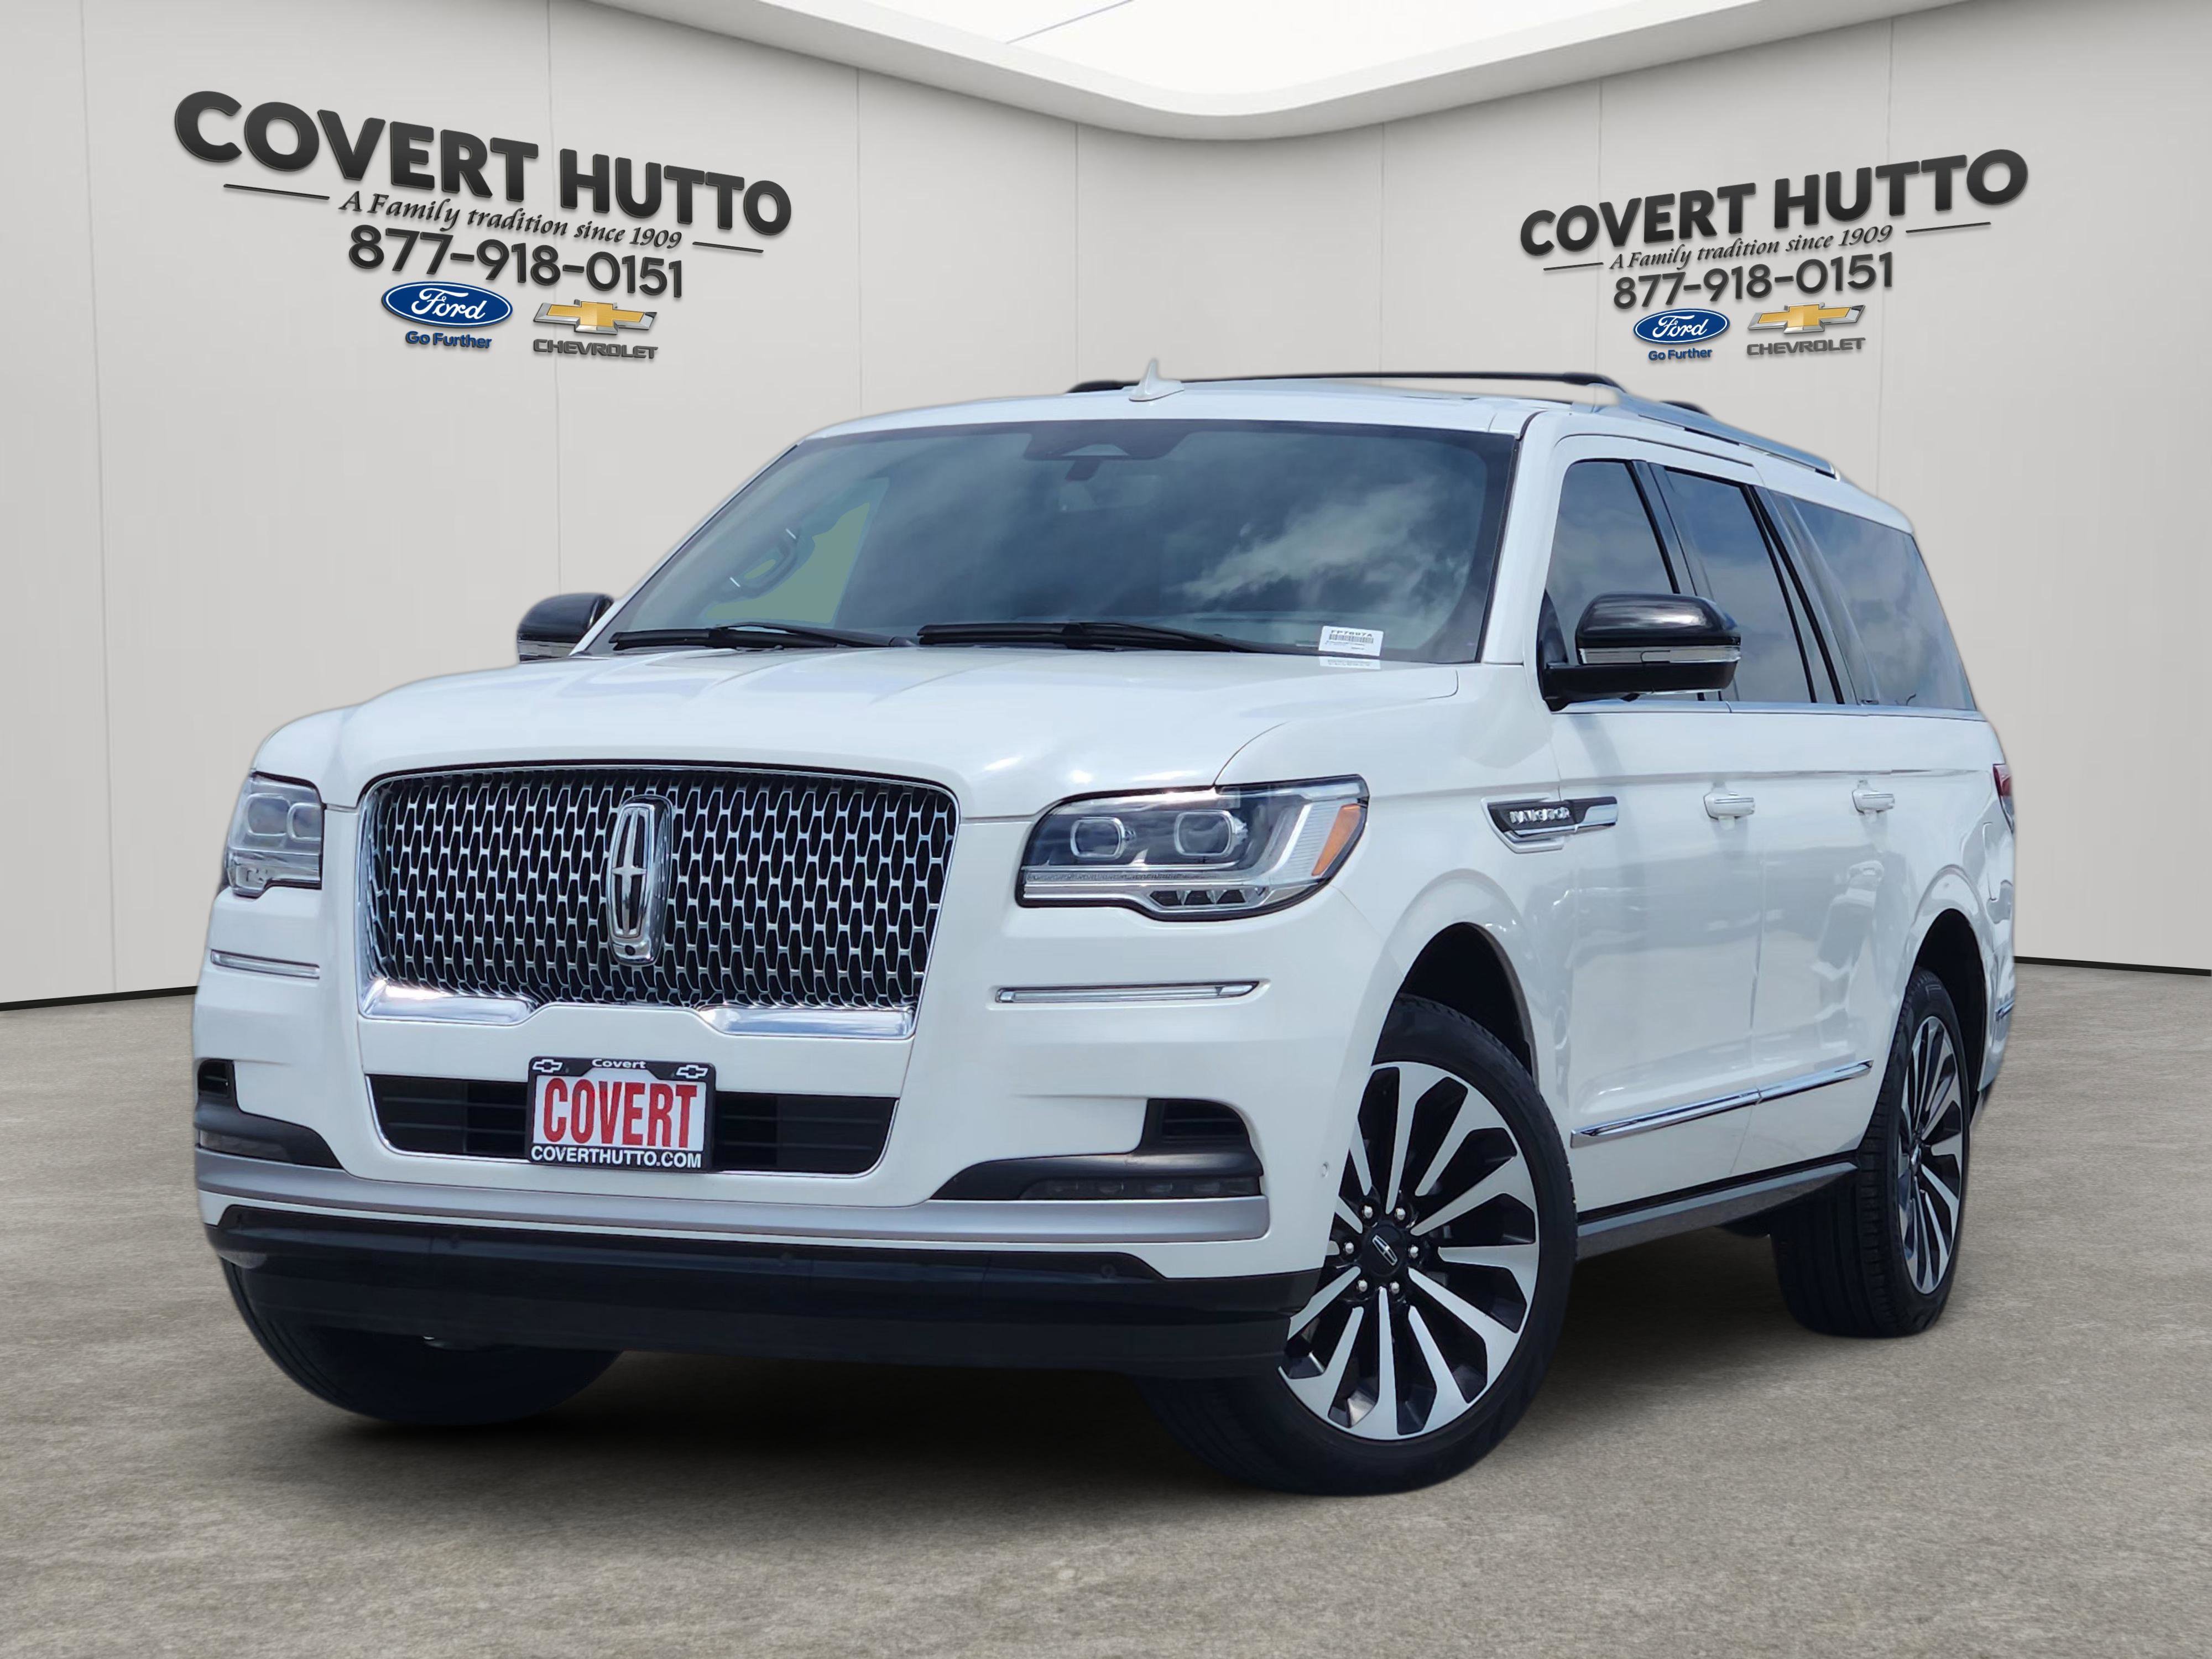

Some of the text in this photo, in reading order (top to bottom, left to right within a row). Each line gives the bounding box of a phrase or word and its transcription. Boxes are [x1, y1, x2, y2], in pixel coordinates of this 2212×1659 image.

[174, 90, 792, 237] COVERT HUTTO
[1520, 148, 2029, 257] COVERT HUTTO
[338, 190, 683, 249] A Family tradition since 1909
[348, 224, 682, 299] 877-918-0151
[1608, 224, 1893, 271] A Family tradition since 1909
[1613, 251, 1893, 310] 877-918-0151
[411, 288, 488, 320] Ford
[404, 330, 493, 349] Go Further
[1652, 314, 1709, 338] Ford
[533, 338, 659, 360] CHEVROLET
[1648, 347, 1713, 361] Go Further
[1746, 337, 1866, 356] CHEVROLET
[591, 1058, 646, 1070] Covert
[542, 1077, 698, 1149] COVERT
[530, 1145, 702, 1169] COVERTHUTTO.COM
